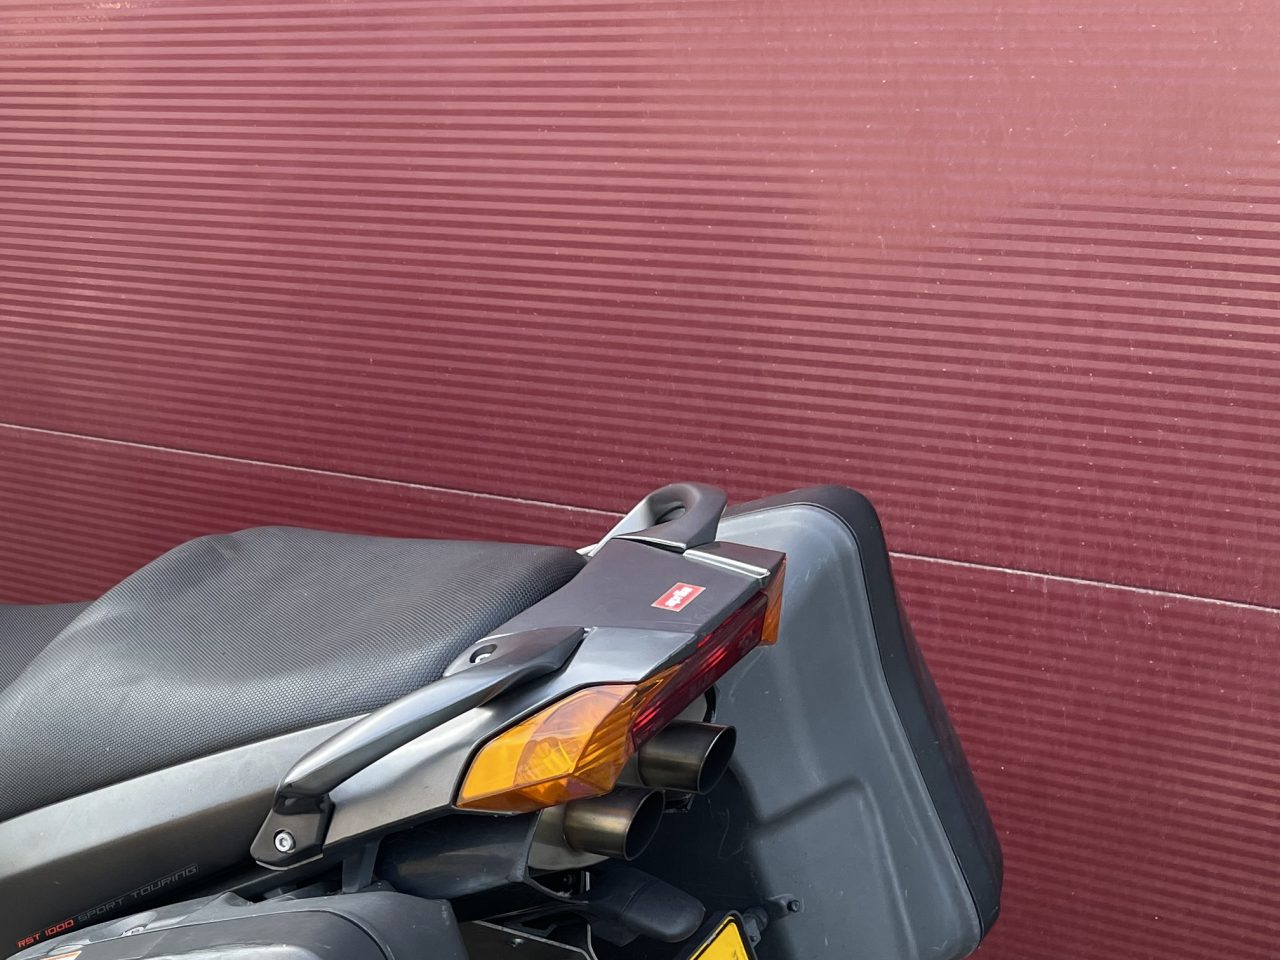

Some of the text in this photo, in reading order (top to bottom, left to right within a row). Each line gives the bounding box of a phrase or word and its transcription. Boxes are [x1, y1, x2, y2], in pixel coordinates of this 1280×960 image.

[17, 932, 41, 949] RST
[78, 897, 126, 923] SPORT
[130, 864, 199, 899] TOURING
